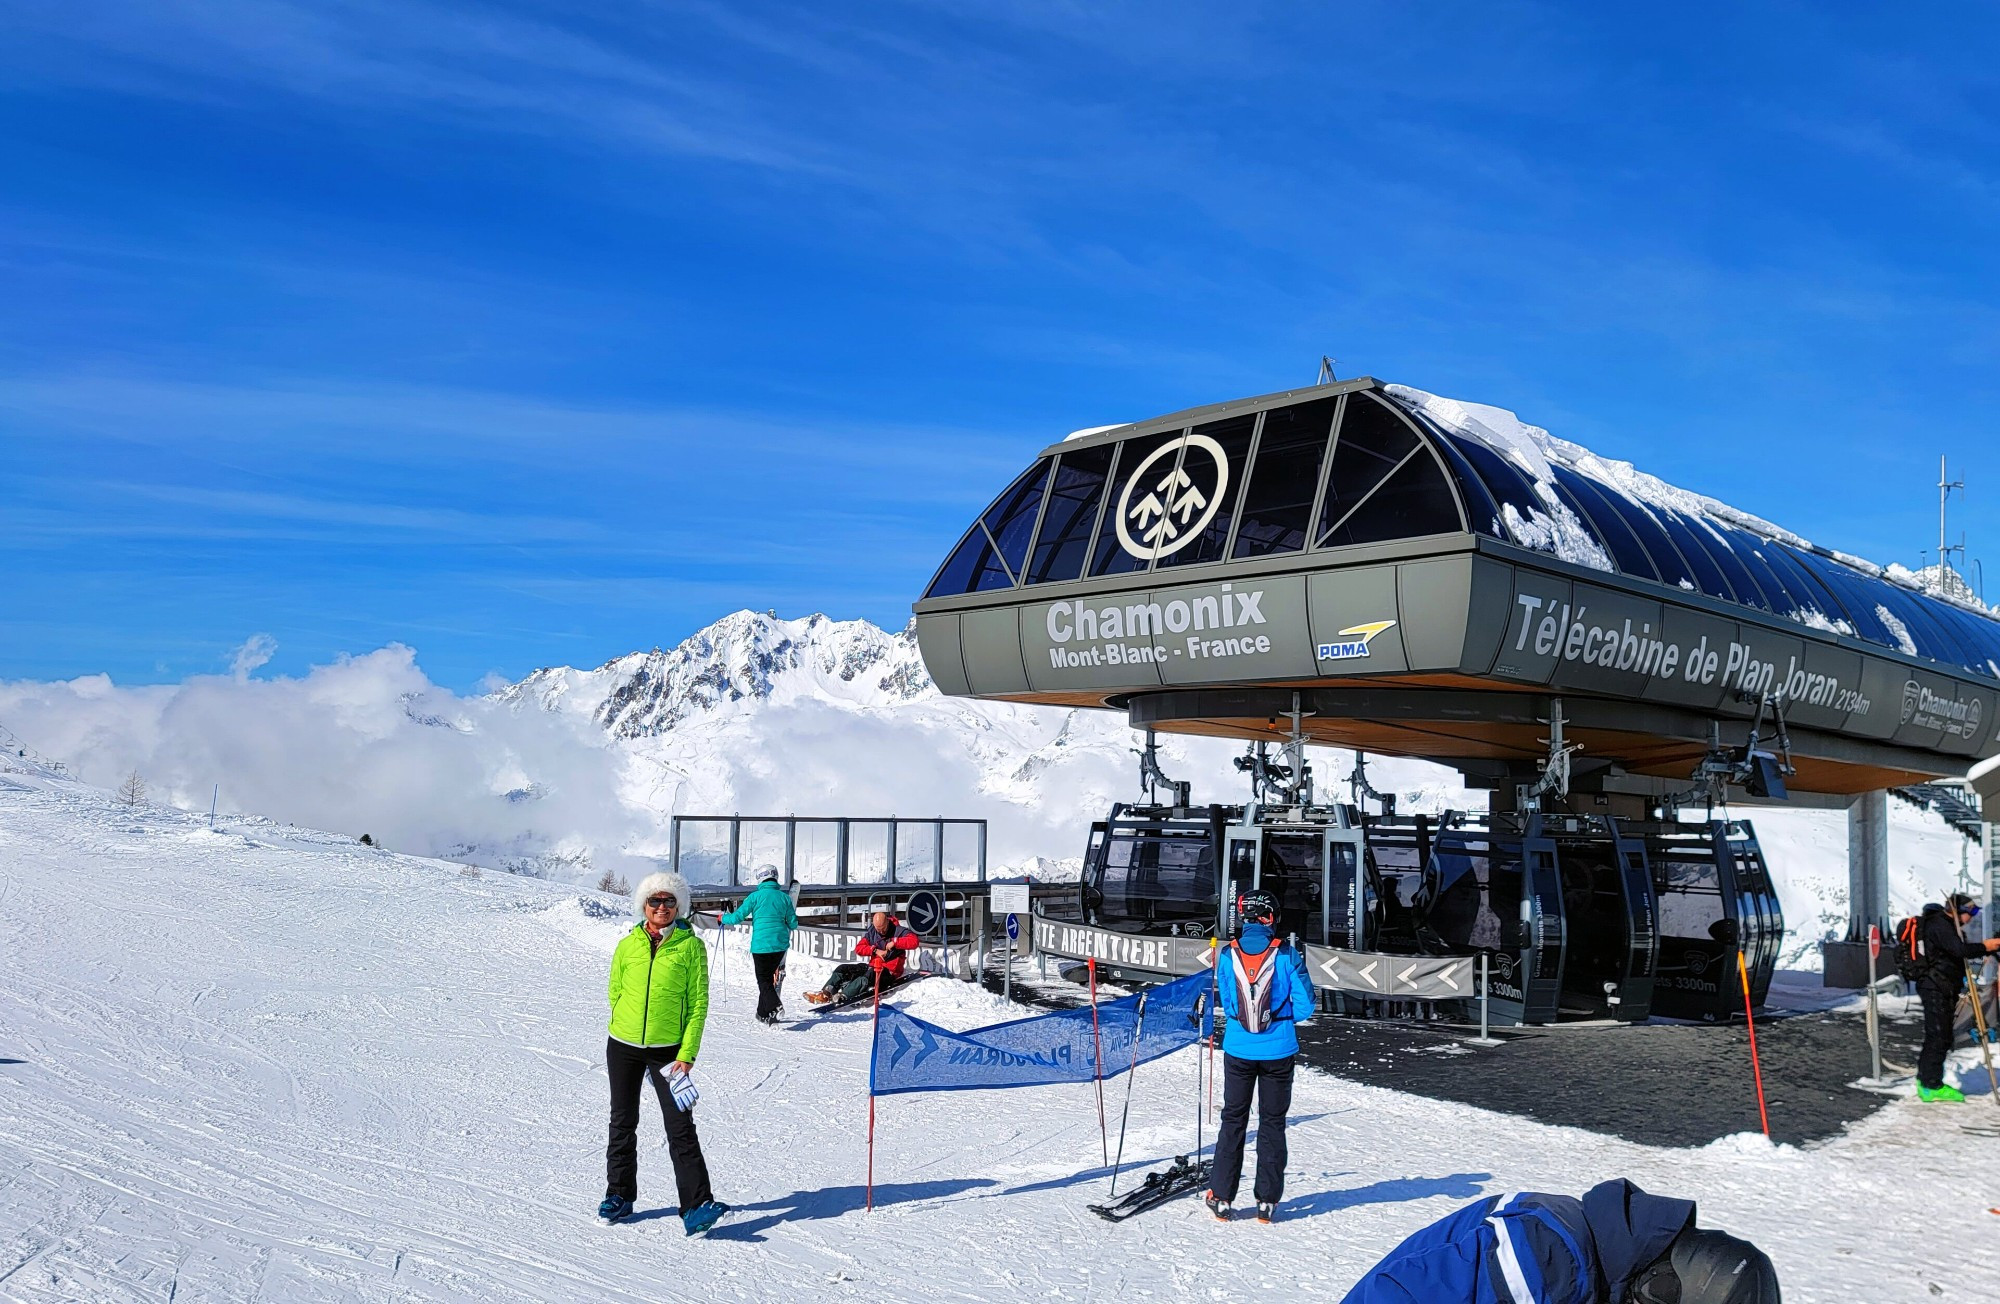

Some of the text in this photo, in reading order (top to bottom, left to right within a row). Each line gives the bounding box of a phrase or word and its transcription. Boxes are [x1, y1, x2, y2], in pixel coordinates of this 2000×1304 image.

[1046, 583, 1266, 643] Chamonix
[1048, 642, 1168, 670] Mont-Blanc
[1188, 633, 1271, 660] France
[1319, 642, 1368, 658] POMA
[1515, 593, 1871, 717] Télécabine de Plan Joran 2134m
[1918, 686, 1969, 721] Chamonix
[1229, 880, 1237, 904] 3300m
[1347, 900, 1355, 916] Plan
[1347, 917, 1355, 927] de
[822, 933, 842, 960] DE
[1061, 927, 1168, 969] ARGENTIERE
[1493, 981, 1523, 1000] 3300m
[1675, 976, 1717, 993] 3300m
[1261, 1009, 1271, 1023] 5
